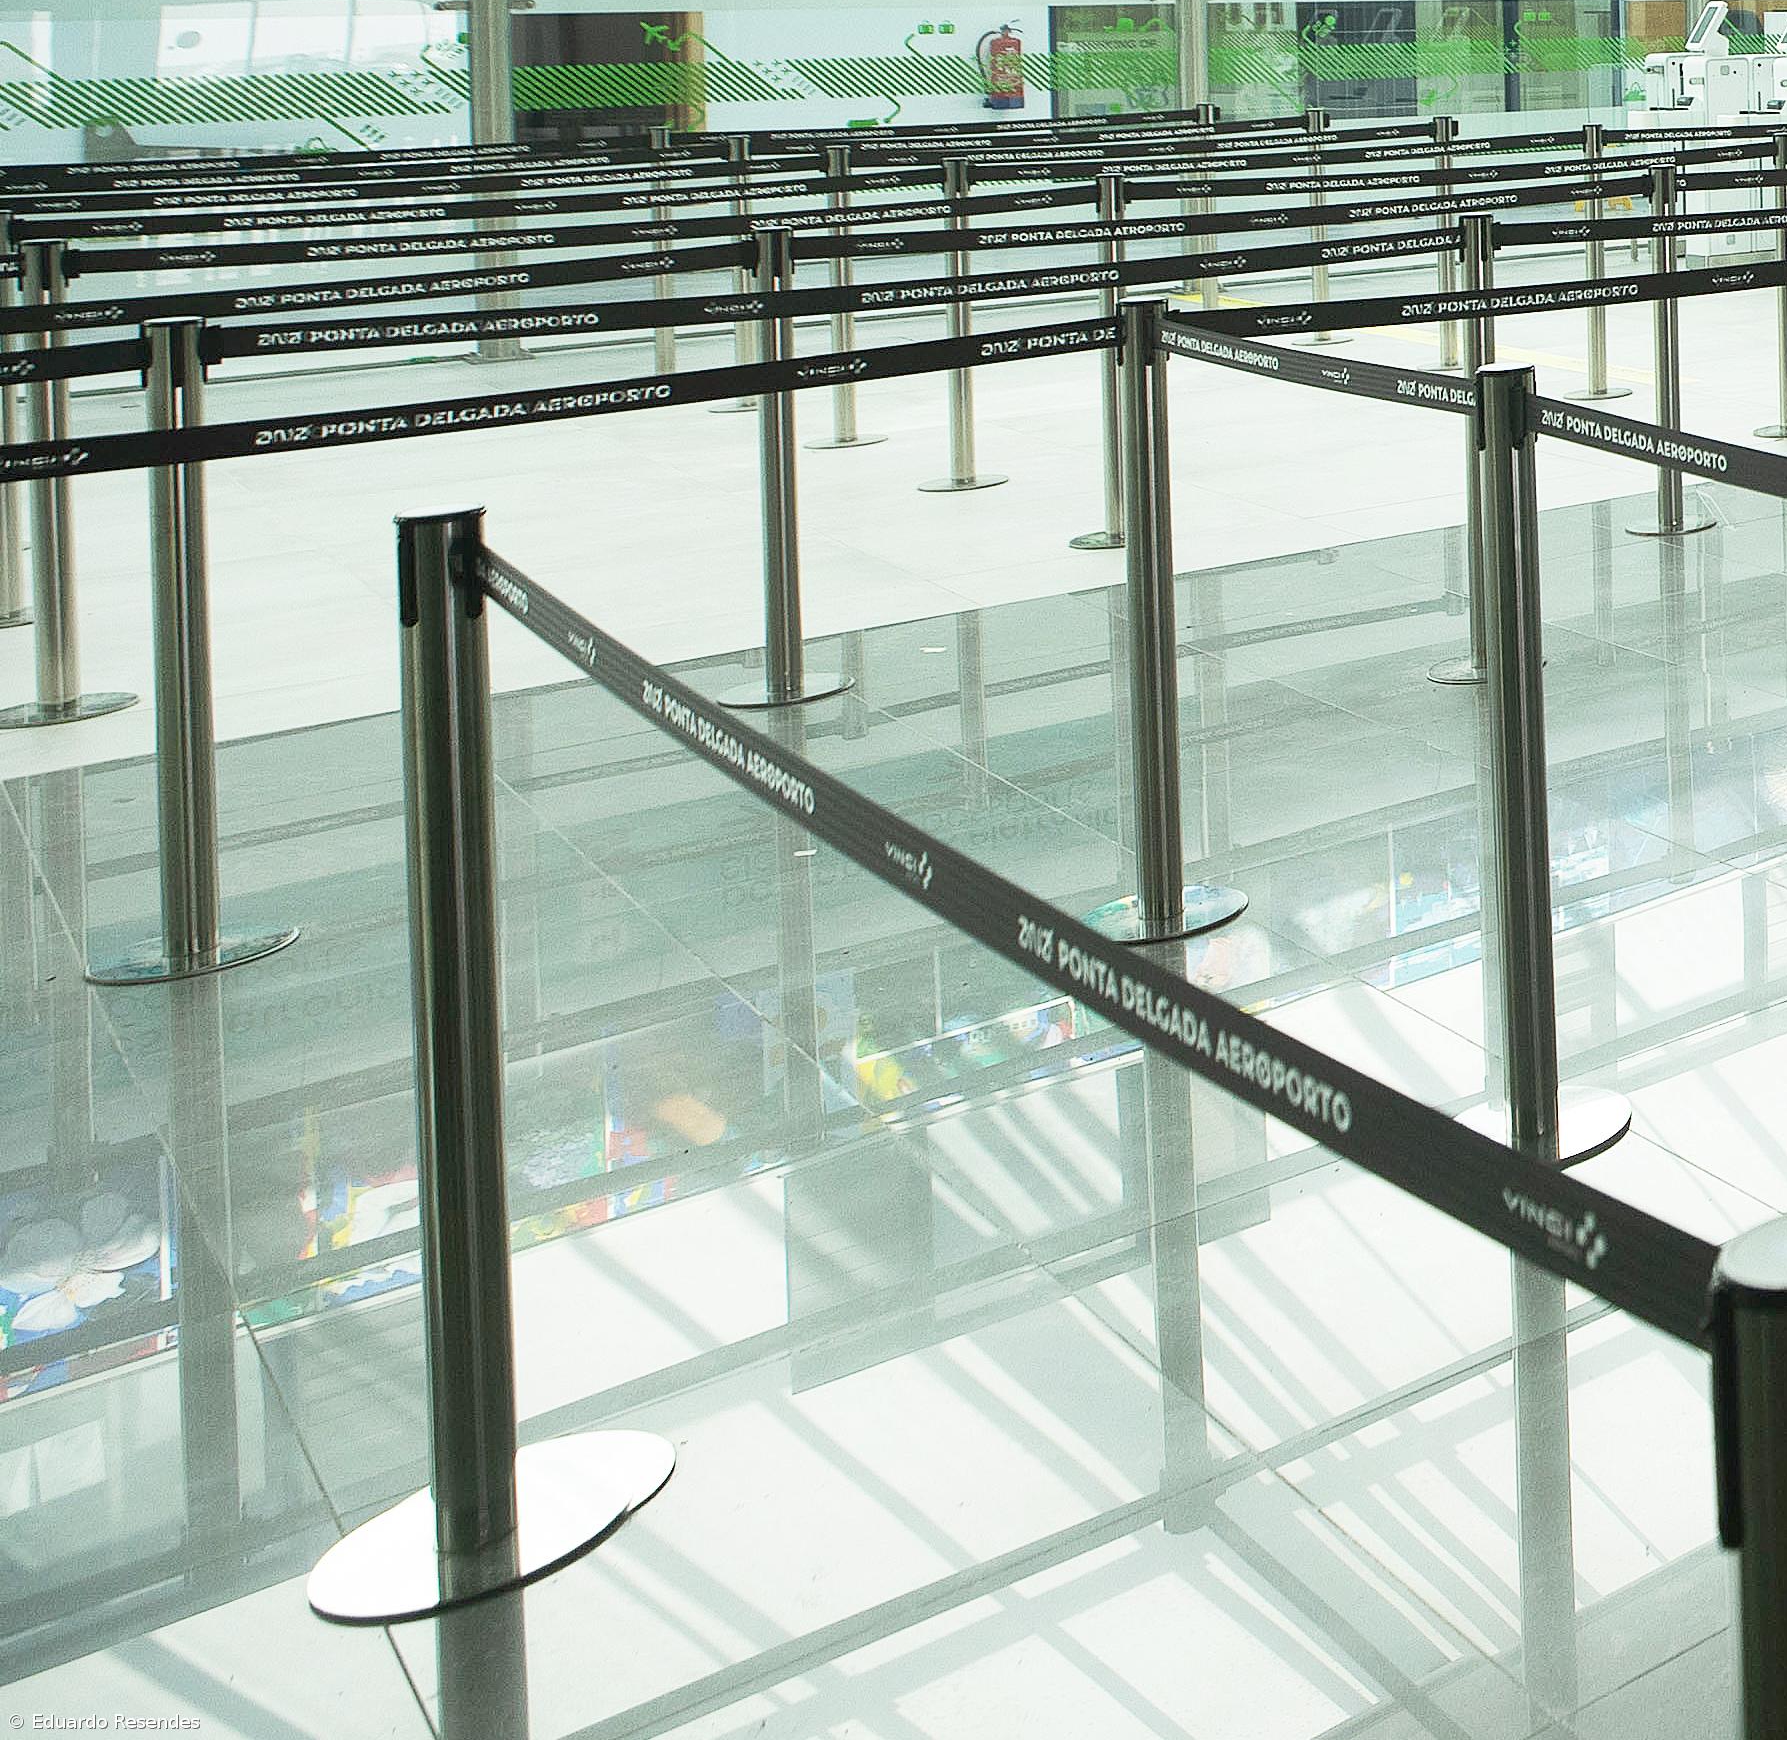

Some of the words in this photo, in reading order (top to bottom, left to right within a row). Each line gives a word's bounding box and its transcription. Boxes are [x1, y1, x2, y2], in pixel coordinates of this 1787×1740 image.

[1177, 334, 1201, 351] PONTA
[1200, 340, 1234, 359] DELGADA
[1233, 349, 1279, 370] AEROPORTO
[1566, 415, 1603, 438] PONTA
[1603, 425, 1655, 453] DELGADA
[1656, 440, 1727, 471] AEROPORTO
[664, 695, 697, 737] PONTA
[697, 717, 745, 768] DELGADA
[746, 751, 814, 813] AEROPORTO
[1058, 940, 1118, 1001] PONTA
[1121, 977, 1211, 1054] DELGADA
[1215, 1033, 1350, 1130] AEROPORTO
